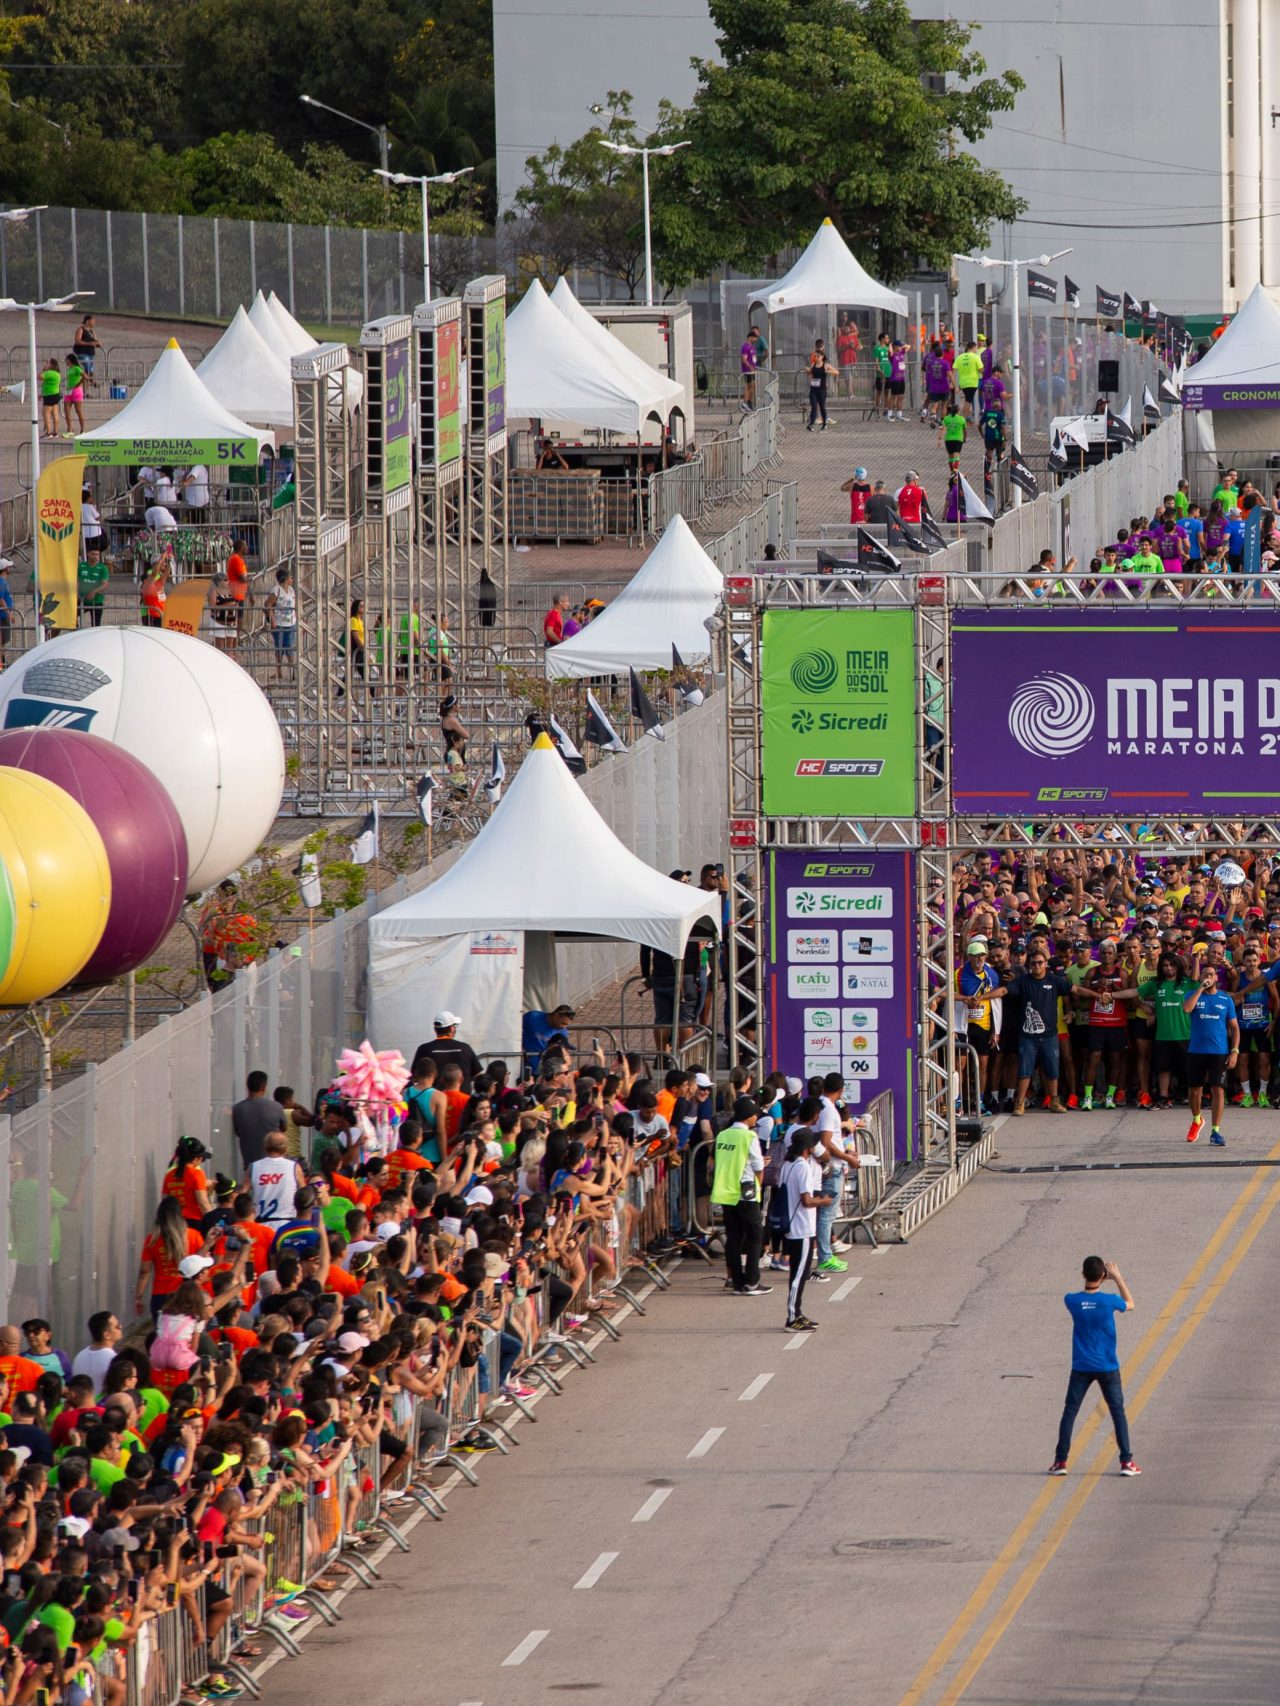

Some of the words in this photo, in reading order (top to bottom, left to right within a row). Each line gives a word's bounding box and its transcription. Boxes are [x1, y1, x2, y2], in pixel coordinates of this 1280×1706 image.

[133, 440, 193, 449] MEDALHA
[217, 443, 246, 460] 5K
[156, 449, 204, 457] HIDRATAÇÃO
[43, 499, 71, 510] SANTA
[40, 508, 75, 521] CLARA
[168, 619, 193, 632] SANTA
[847, 651, 889, 669] MEIA
[860, 675, 889, 693] SOL
[1107, 679, 1244, 739] MEIA
[818, 713, 888, 730] Sicredi
[1108, 742, 1244, 755] MARATONA
[801, 763, 820, 772] HC
[829, 763, 878, 773] SPORTS
[820, 895, 883, 910] Sicredi
[796, 972, 831, 984] ICATU
[861, 980, 889, 988] NATAL
[811, 1036, 833, 1051] selfit
[851, 1060, 870, 1072] 96
[716, 1143, 736, 1151] STAFF
[258, 1173, 284, 1186] SKY
[259, 1199, 279, 1218] 12
